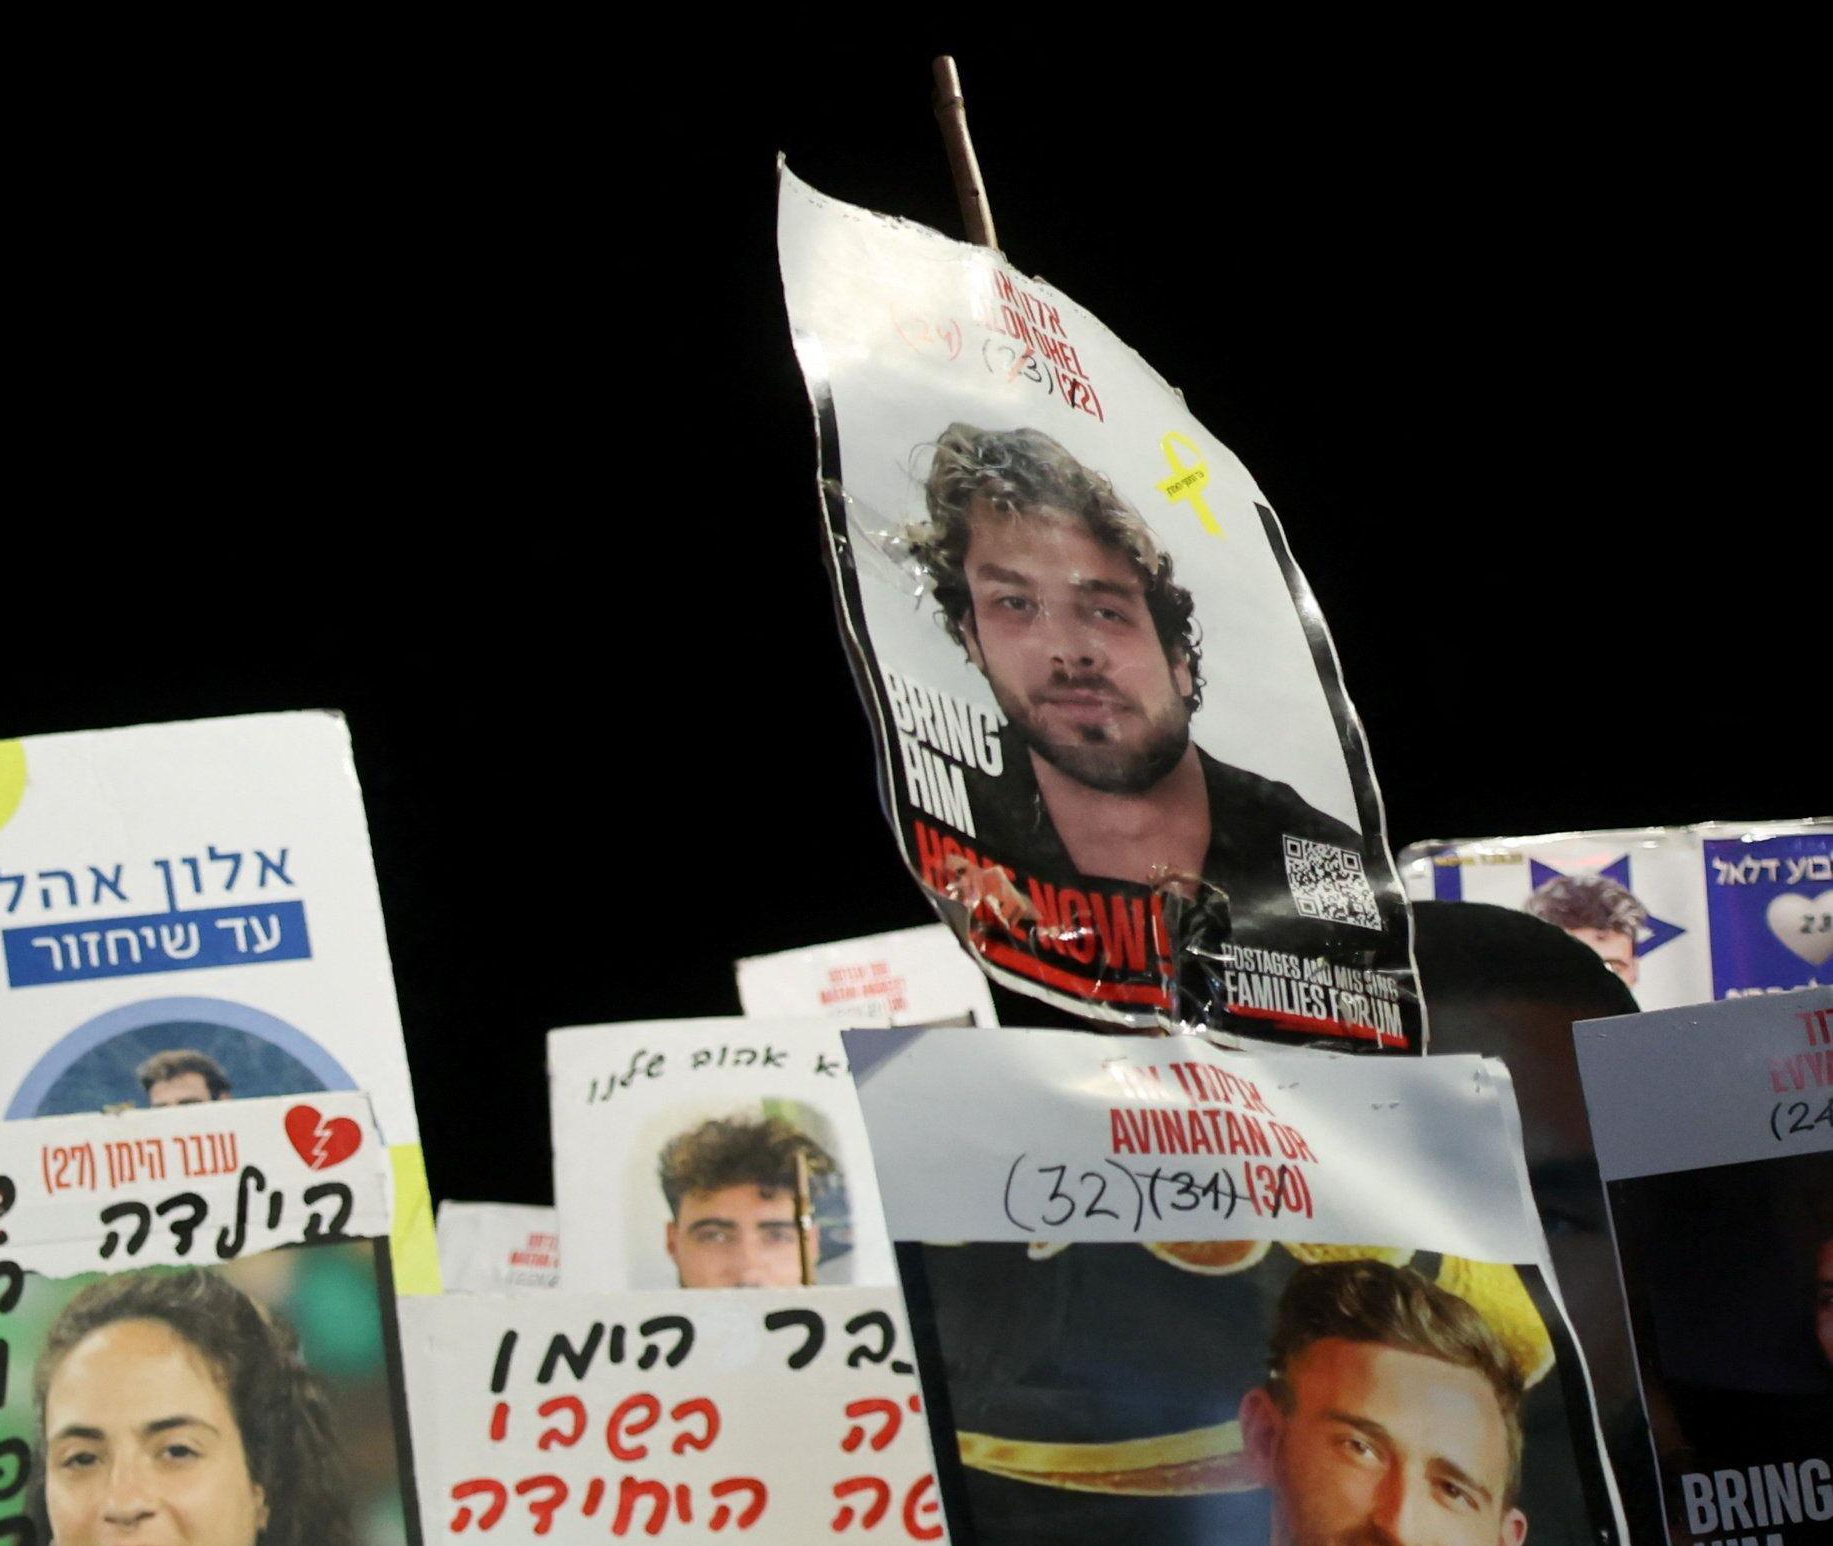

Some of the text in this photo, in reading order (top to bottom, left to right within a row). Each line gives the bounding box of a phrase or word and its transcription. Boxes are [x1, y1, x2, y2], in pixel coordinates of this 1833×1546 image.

[882, 665, 1009, 777] BRING
[902, 740, 977, 840] HIM
[154, 845, 297, 914] אלון
[32, 914, 283, 972] עד שיחזור
[41, 1131, 240, 1195] ענבר הימן (27)
[1109, 1107, 1319, 1164] AVINATAN OR
[100, 1165, 354, 1260] הילדה
[766, 1308, 913, 1375] בר
[490, 1395, 721, 1462] בשבי
[1683, 1457, 1833, 1537] BRING
